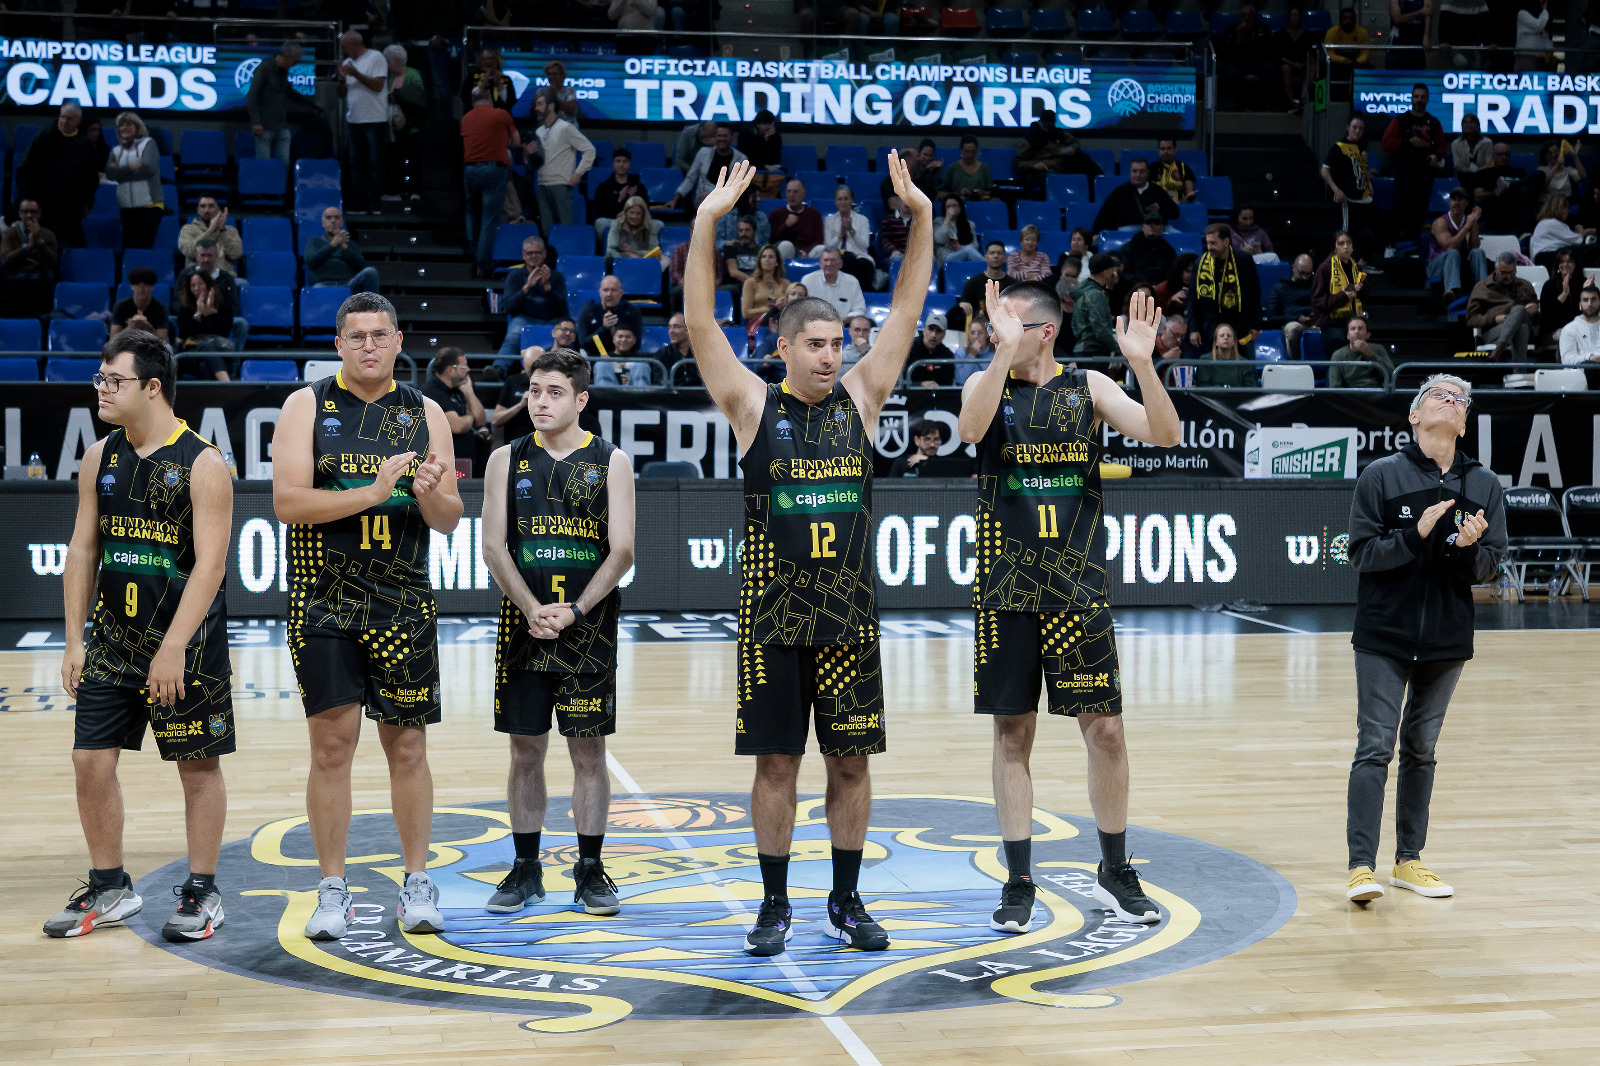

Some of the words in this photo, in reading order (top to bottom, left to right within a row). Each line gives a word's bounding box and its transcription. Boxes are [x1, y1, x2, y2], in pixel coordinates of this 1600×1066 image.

[127, 45, 216, 64] LEAGUE
[624, 58, 733, 77] OFFICIAL
[736, 61, 872, 80] BASKETBALL
[876, 64, 1007, 83] CHAMPIONS
[1010, 68, 1091, 85] LEAGUE
[6, 62, 217, 109] CARDS
[1443, 73, 1544, 91] OFFICIAL
[624, 79, 893, 125] TRADING
[902, 84, 1092, 129] CARDS
[1016, 440, 1089, 454] FUNDACIÓN
[791, 453, 862, 470] FUNDACIÓN
[1017, 453, 1032, 463] CB
[1034, 452, 1089, 463] CANARIAS
[1165, 454, 1209, 469] Martín
[1272, 446, 1342, 474] FINISHER
[340, 463, 358, 473] CB
[791, 468, 806, 479] CB
[808, 466, 863, 480] CANARIAS
[1022, 475, 1084, 489] cajasiete
[795, 490, 859, 508] cajasiete
[532, 514, 599, 536] FUNDACIÓN
[1037, 504, 1059, 538] 11
[111, 526, 126, 537] CB
[128, 527, 179, 545] CANARIAS
[360, 515, 392, 550] 14
[532, 525, 547, 535] CB
[809, 521, 837, 559] 12
[535, 546, 596, 561] cajasiete
[877, 514, 940, 587] OF
[551, 574, 566, 605] 5
[125, 581, 138, 618] 9
[1056, 680, 1094, 689] Canarias
[1073, 673, 1094, 681] Islas
[379, 688, 416, 703] Canarias
[397, 687, 417, 696] Islas
[555, 702, 589, 713] Canarias
[570, 697, 589, 706] Islas
[166, 722, 187, 731] Islas
[831, 721, 868, 731] Canarias
[848, 714, 868, 723] Islas
[927, 960, 1033, 983] LA
